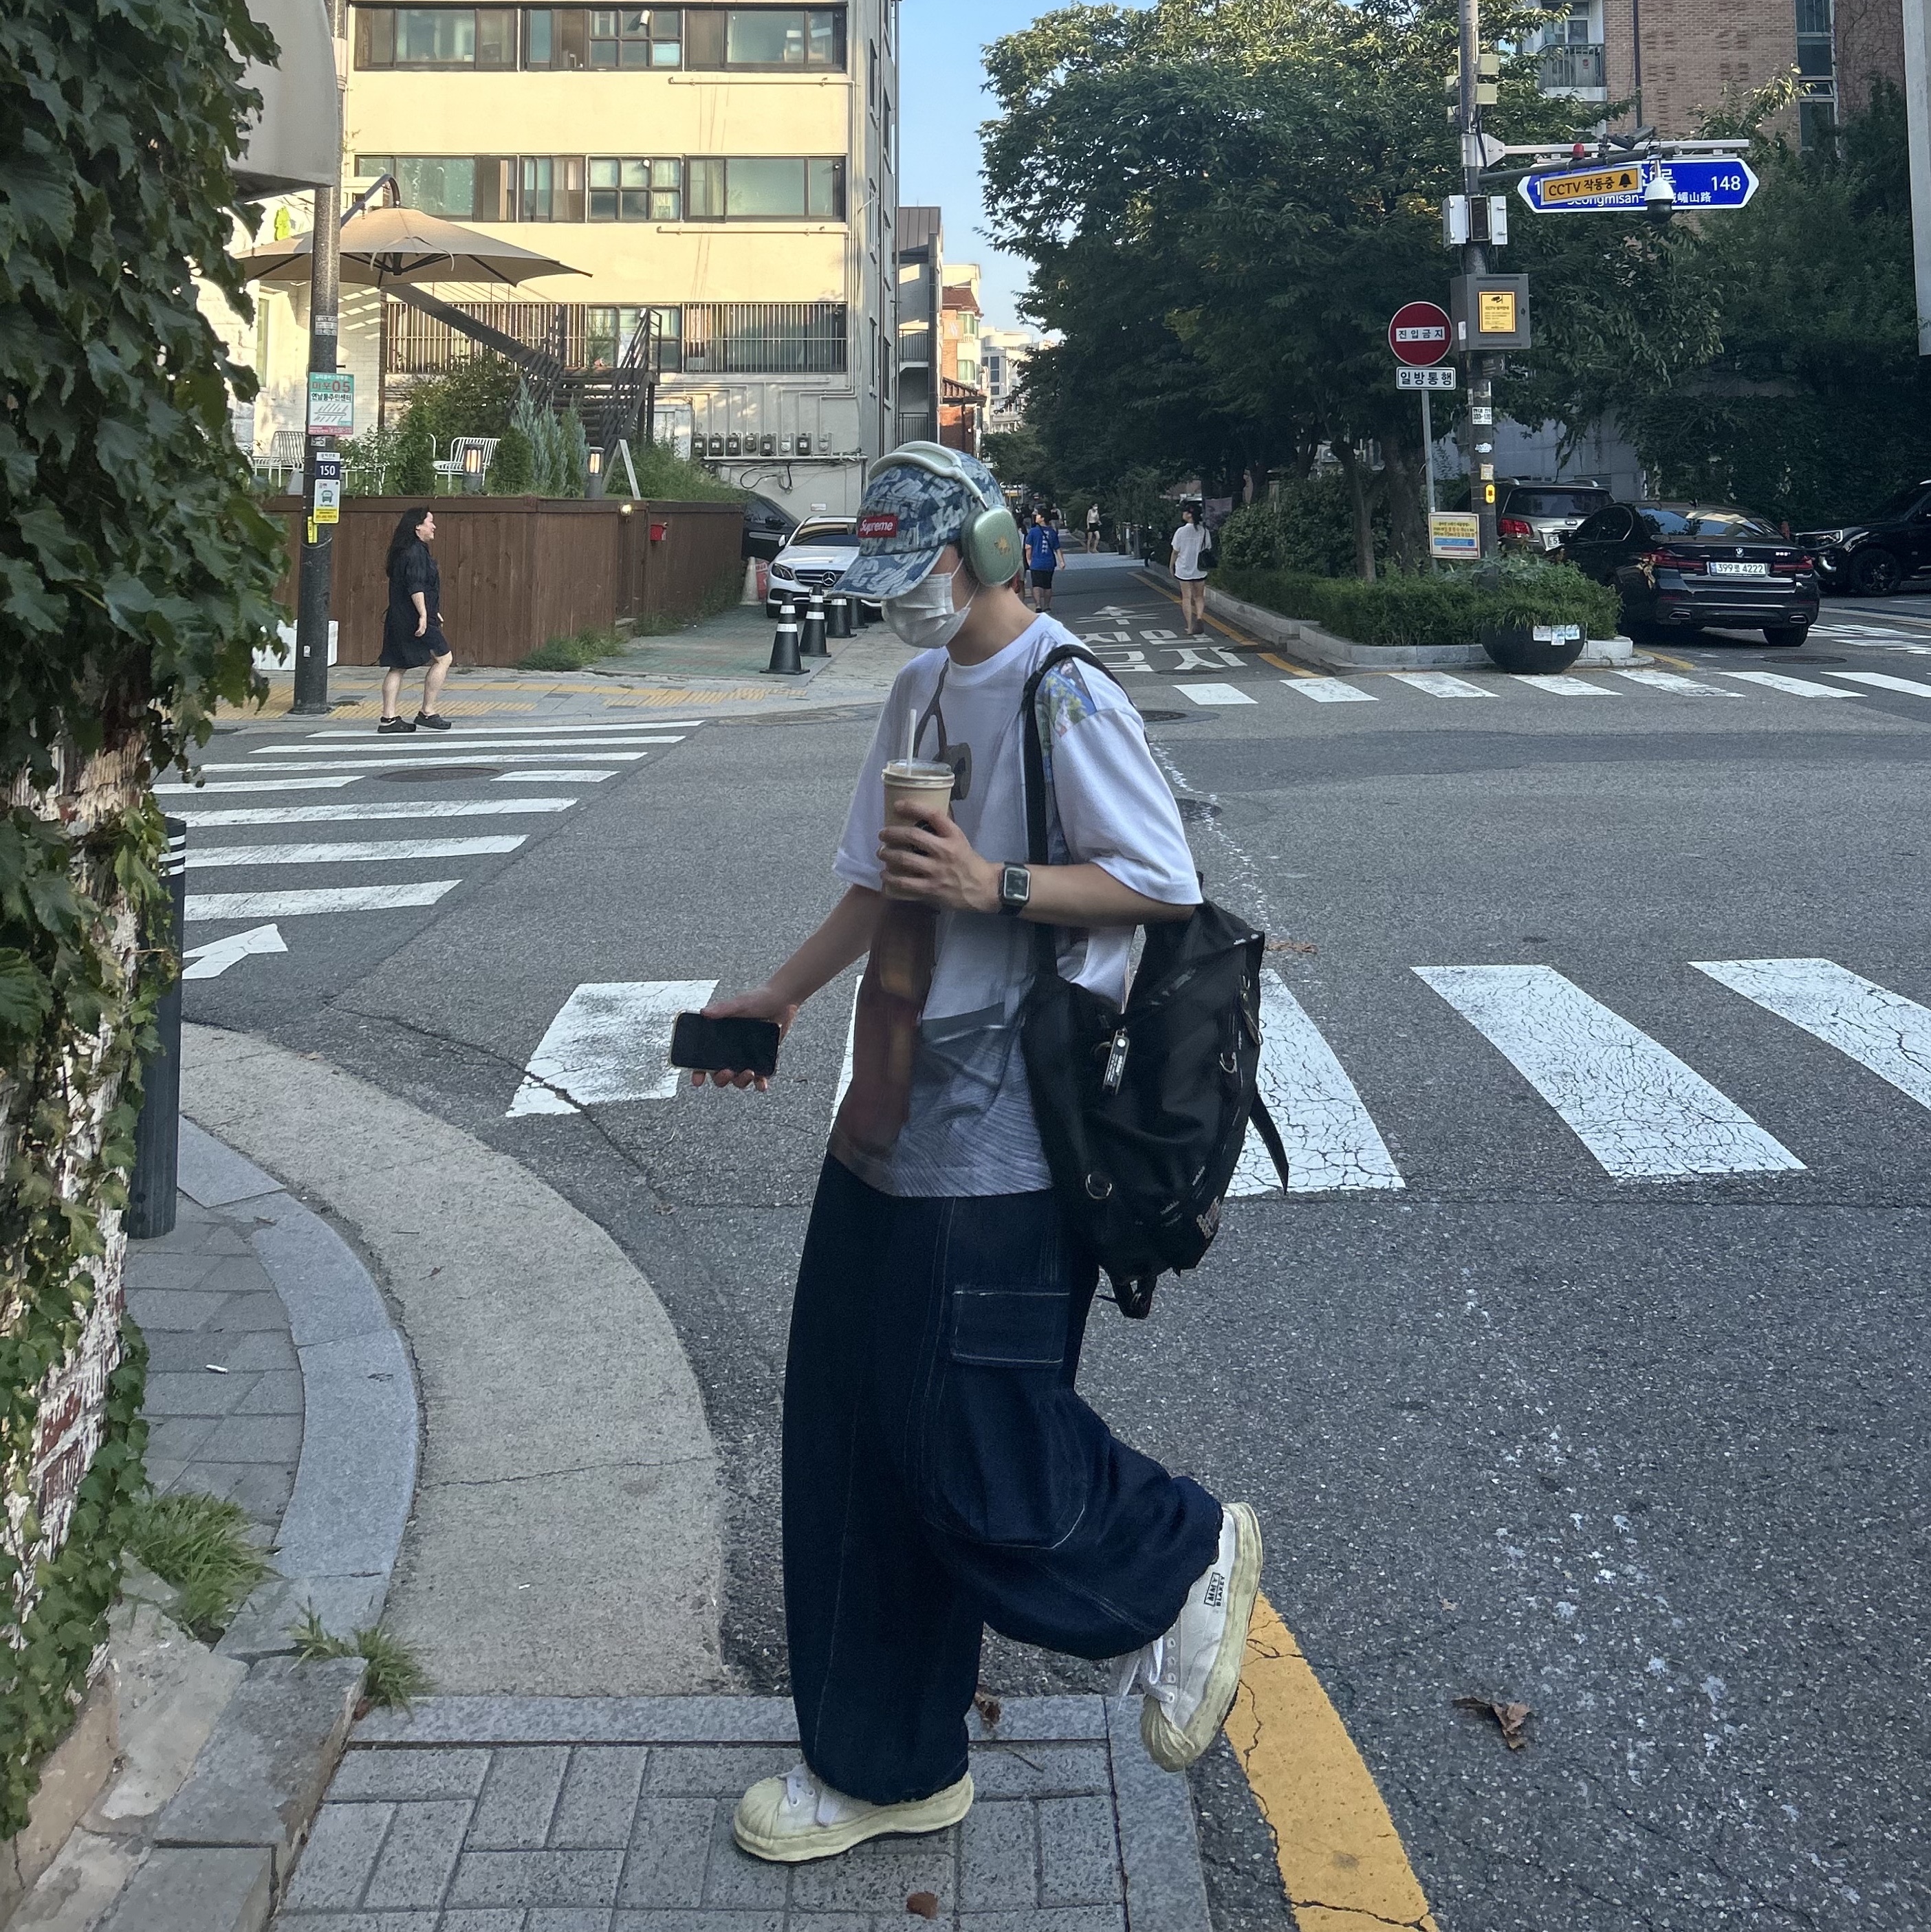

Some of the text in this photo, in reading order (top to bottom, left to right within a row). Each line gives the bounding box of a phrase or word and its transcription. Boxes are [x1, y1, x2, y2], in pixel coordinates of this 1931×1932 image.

[1549, 181, 1581, 197] CCTV
[1584, 177, 1615, 192] 작동중
[1711, 176, 1741, 191] 148
[1398, 329, 1443, 339] 진입금지
[1400, 372, 1452, 386] 일방통행
[311, 393, 352, 402] 연남동주민센터
[320, 465, 336, 476] 150
[860, 518, 894, 535] Supreme
[1742, 564, 1763, 573] 4222
